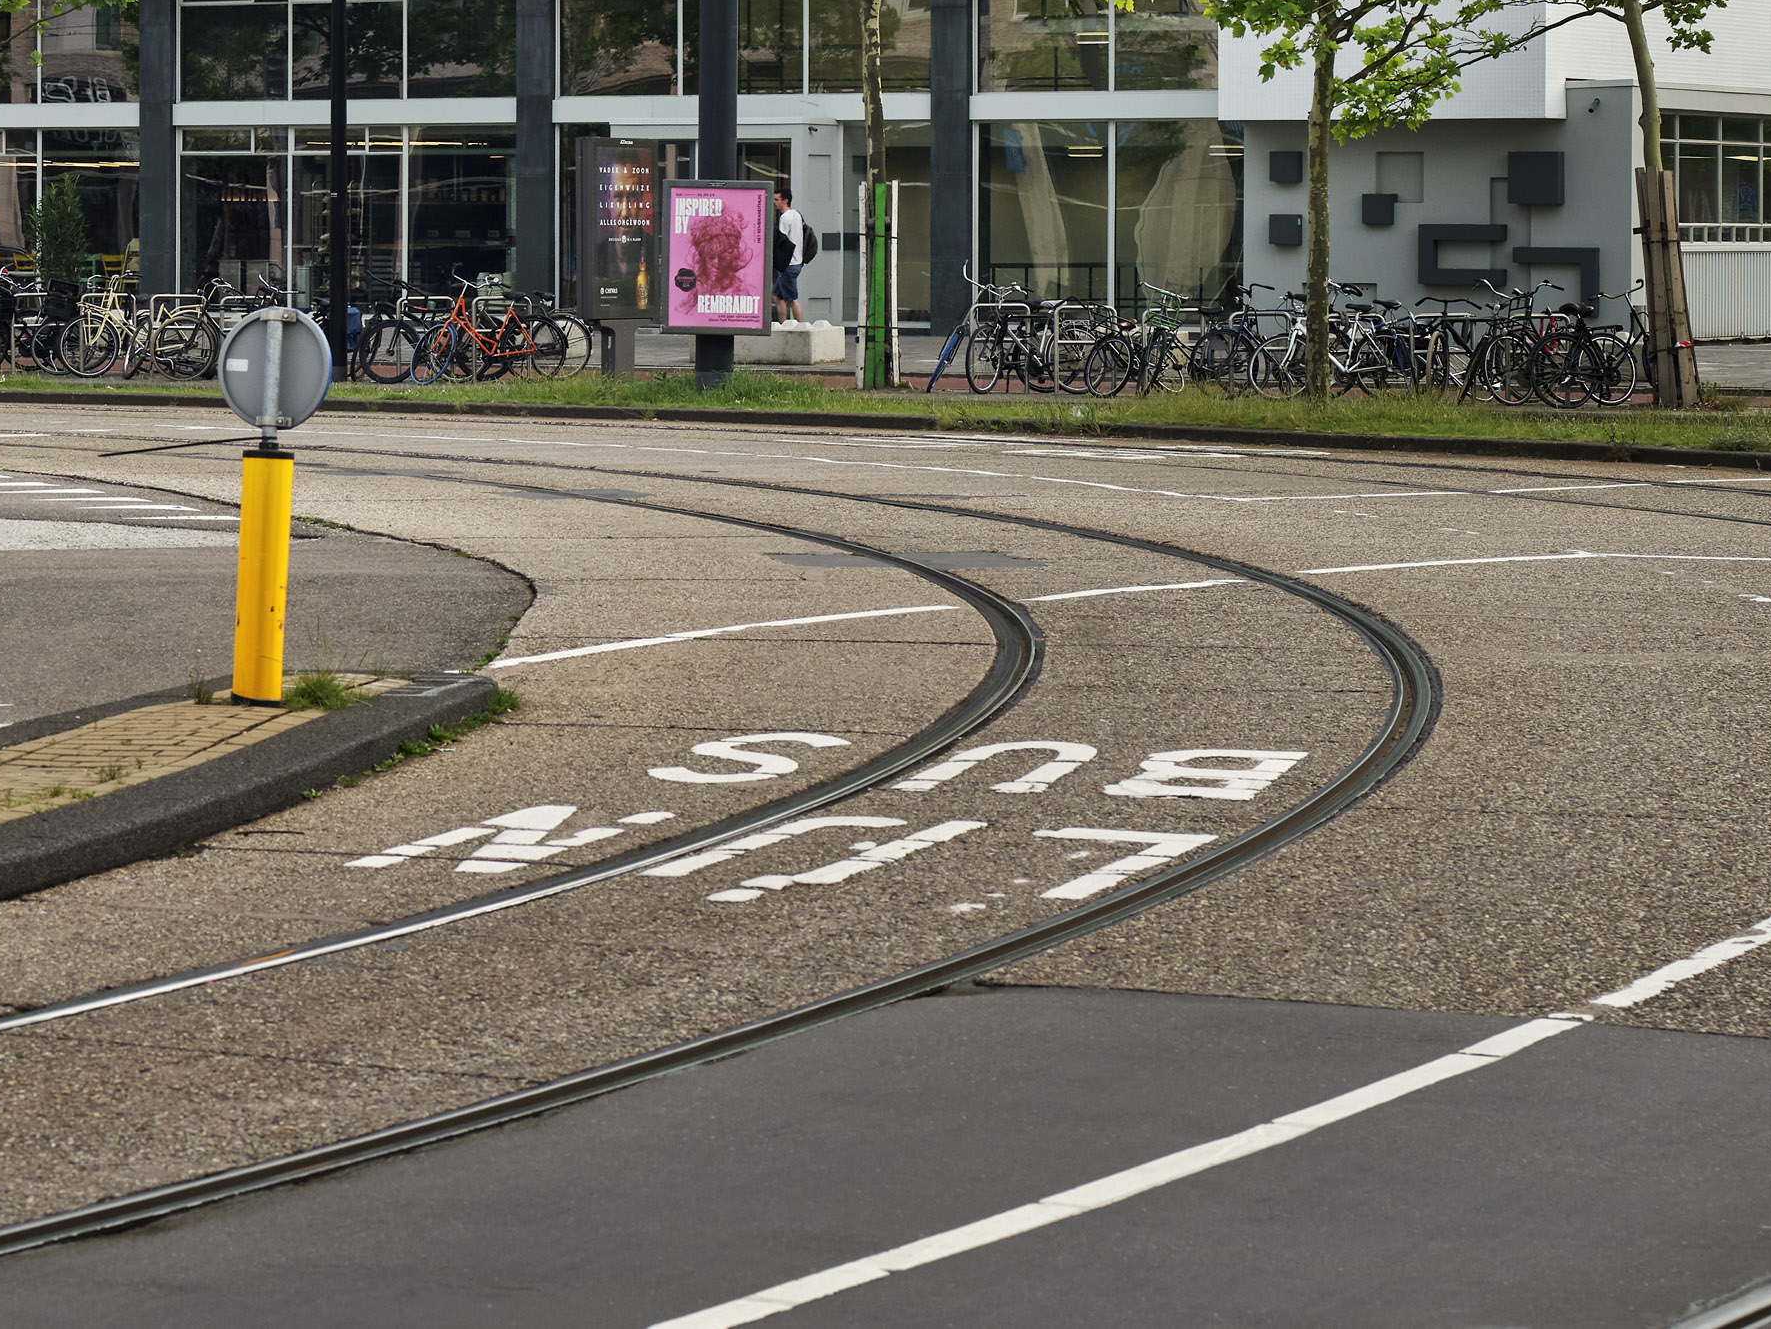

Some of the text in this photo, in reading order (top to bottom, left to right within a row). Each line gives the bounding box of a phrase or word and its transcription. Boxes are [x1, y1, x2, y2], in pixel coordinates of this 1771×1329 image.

[675, 198, 722, 217] INSPIRED
[675, 216, 689, 234] BY
[697, 295, 760, 314] REMBRANDT
